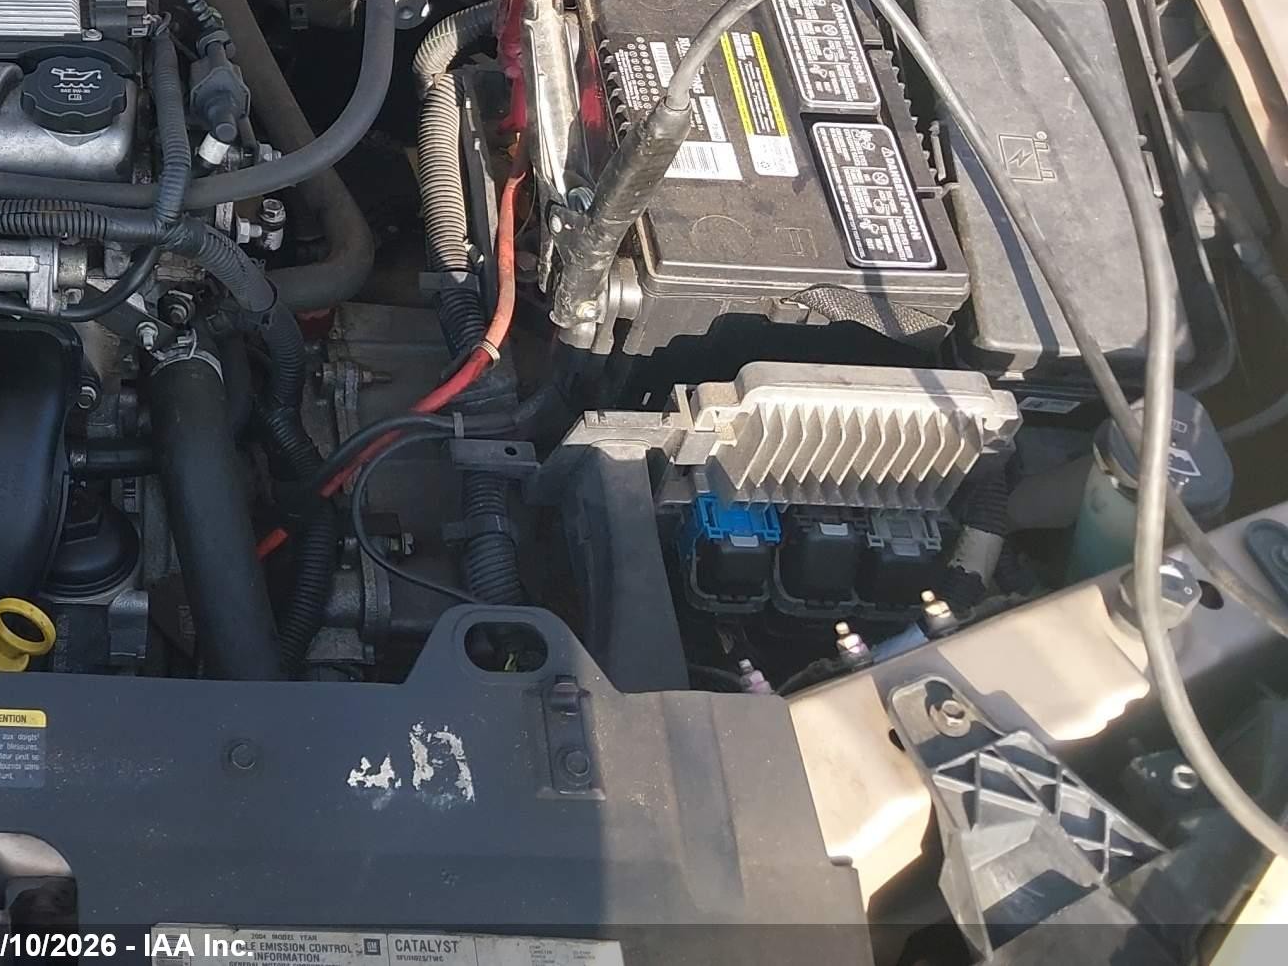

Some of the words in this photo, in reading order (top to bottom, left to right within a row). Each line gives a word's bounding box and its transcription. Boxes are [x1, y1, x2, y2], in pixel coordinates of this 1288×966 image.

[834, 12, 867, 83] DANGER/POISON
[884, 157, 923, 240] DANGER/POISON
[259, 942, 306, 952] EMISSION
[309, 943, 352, 953] CONTROL
[394, 939, 458, 953] CATALYST
[253, 953, 320, 962] INFORMATION
